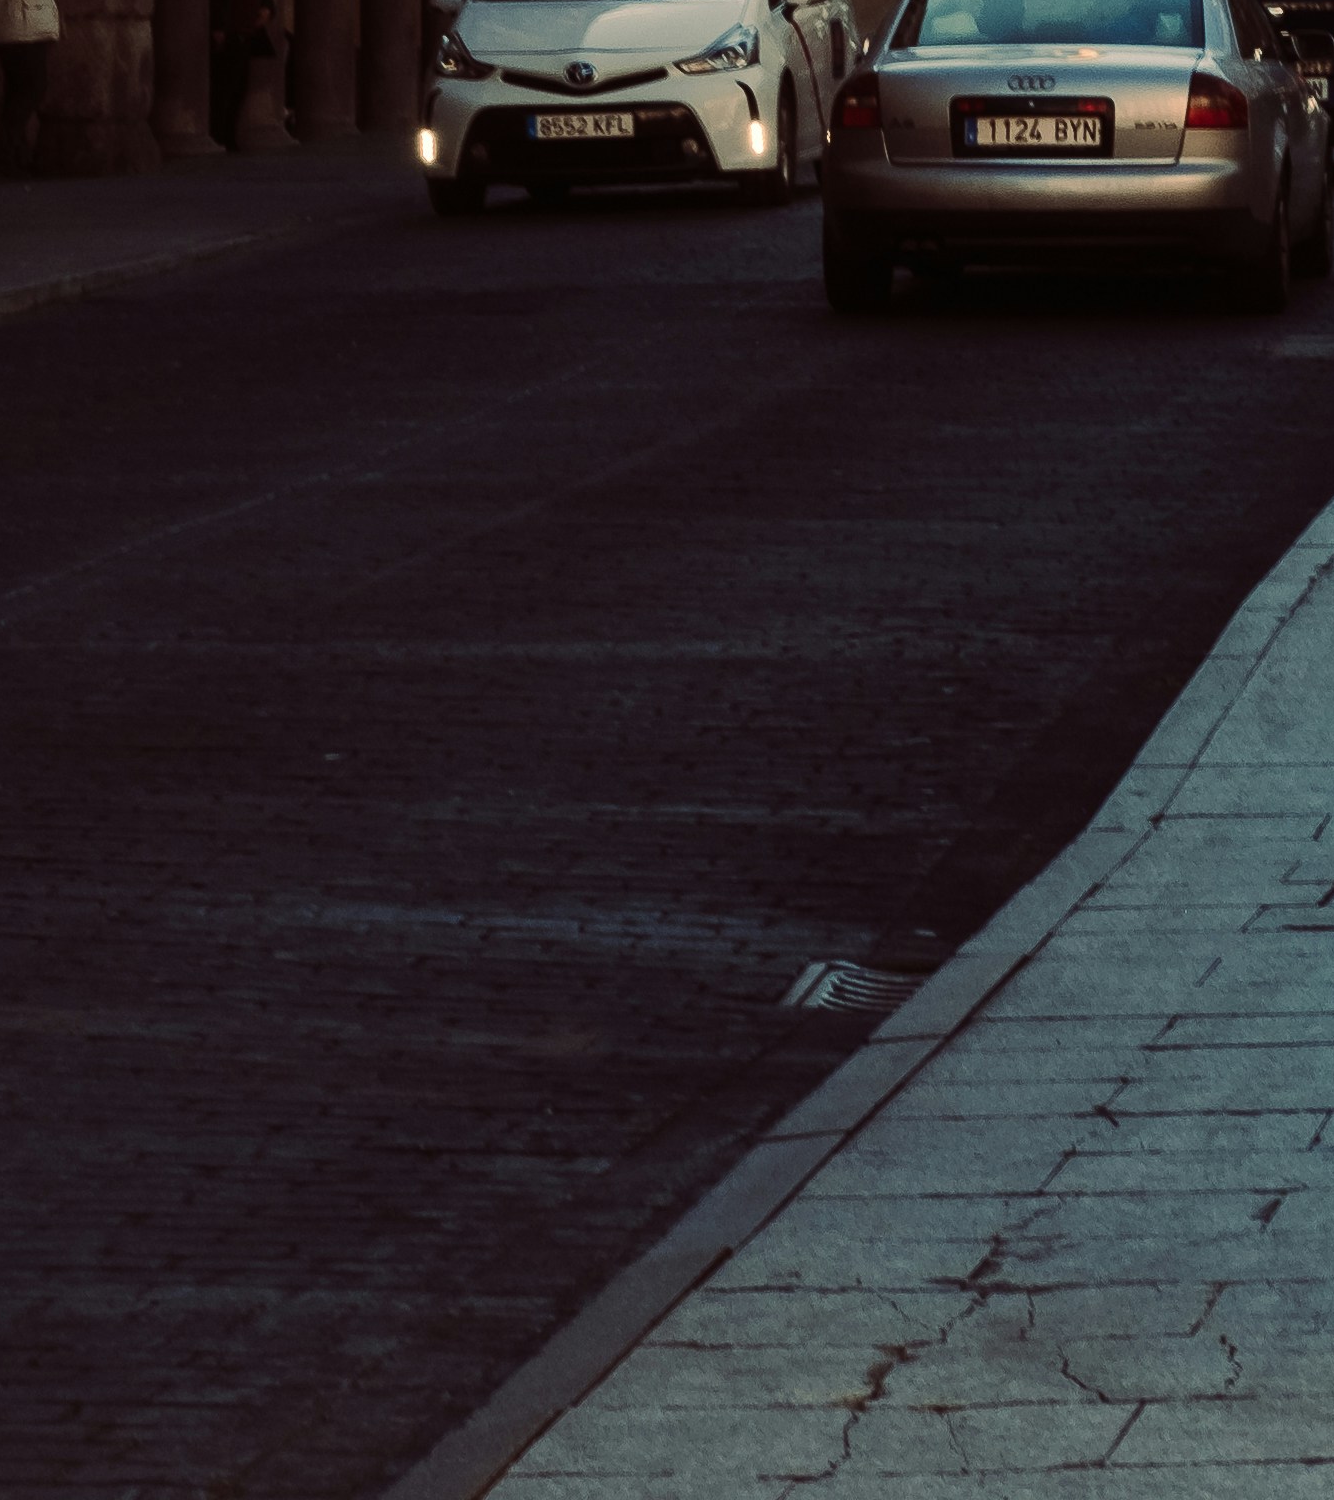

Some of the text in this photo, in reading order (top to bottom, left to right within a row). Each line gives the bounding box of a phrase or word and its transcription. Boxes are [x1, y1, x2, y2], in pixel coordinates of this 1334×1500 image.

[592, 114, 630, 135] KFL
[988, 119, 1097, 143] 1124 BYN
